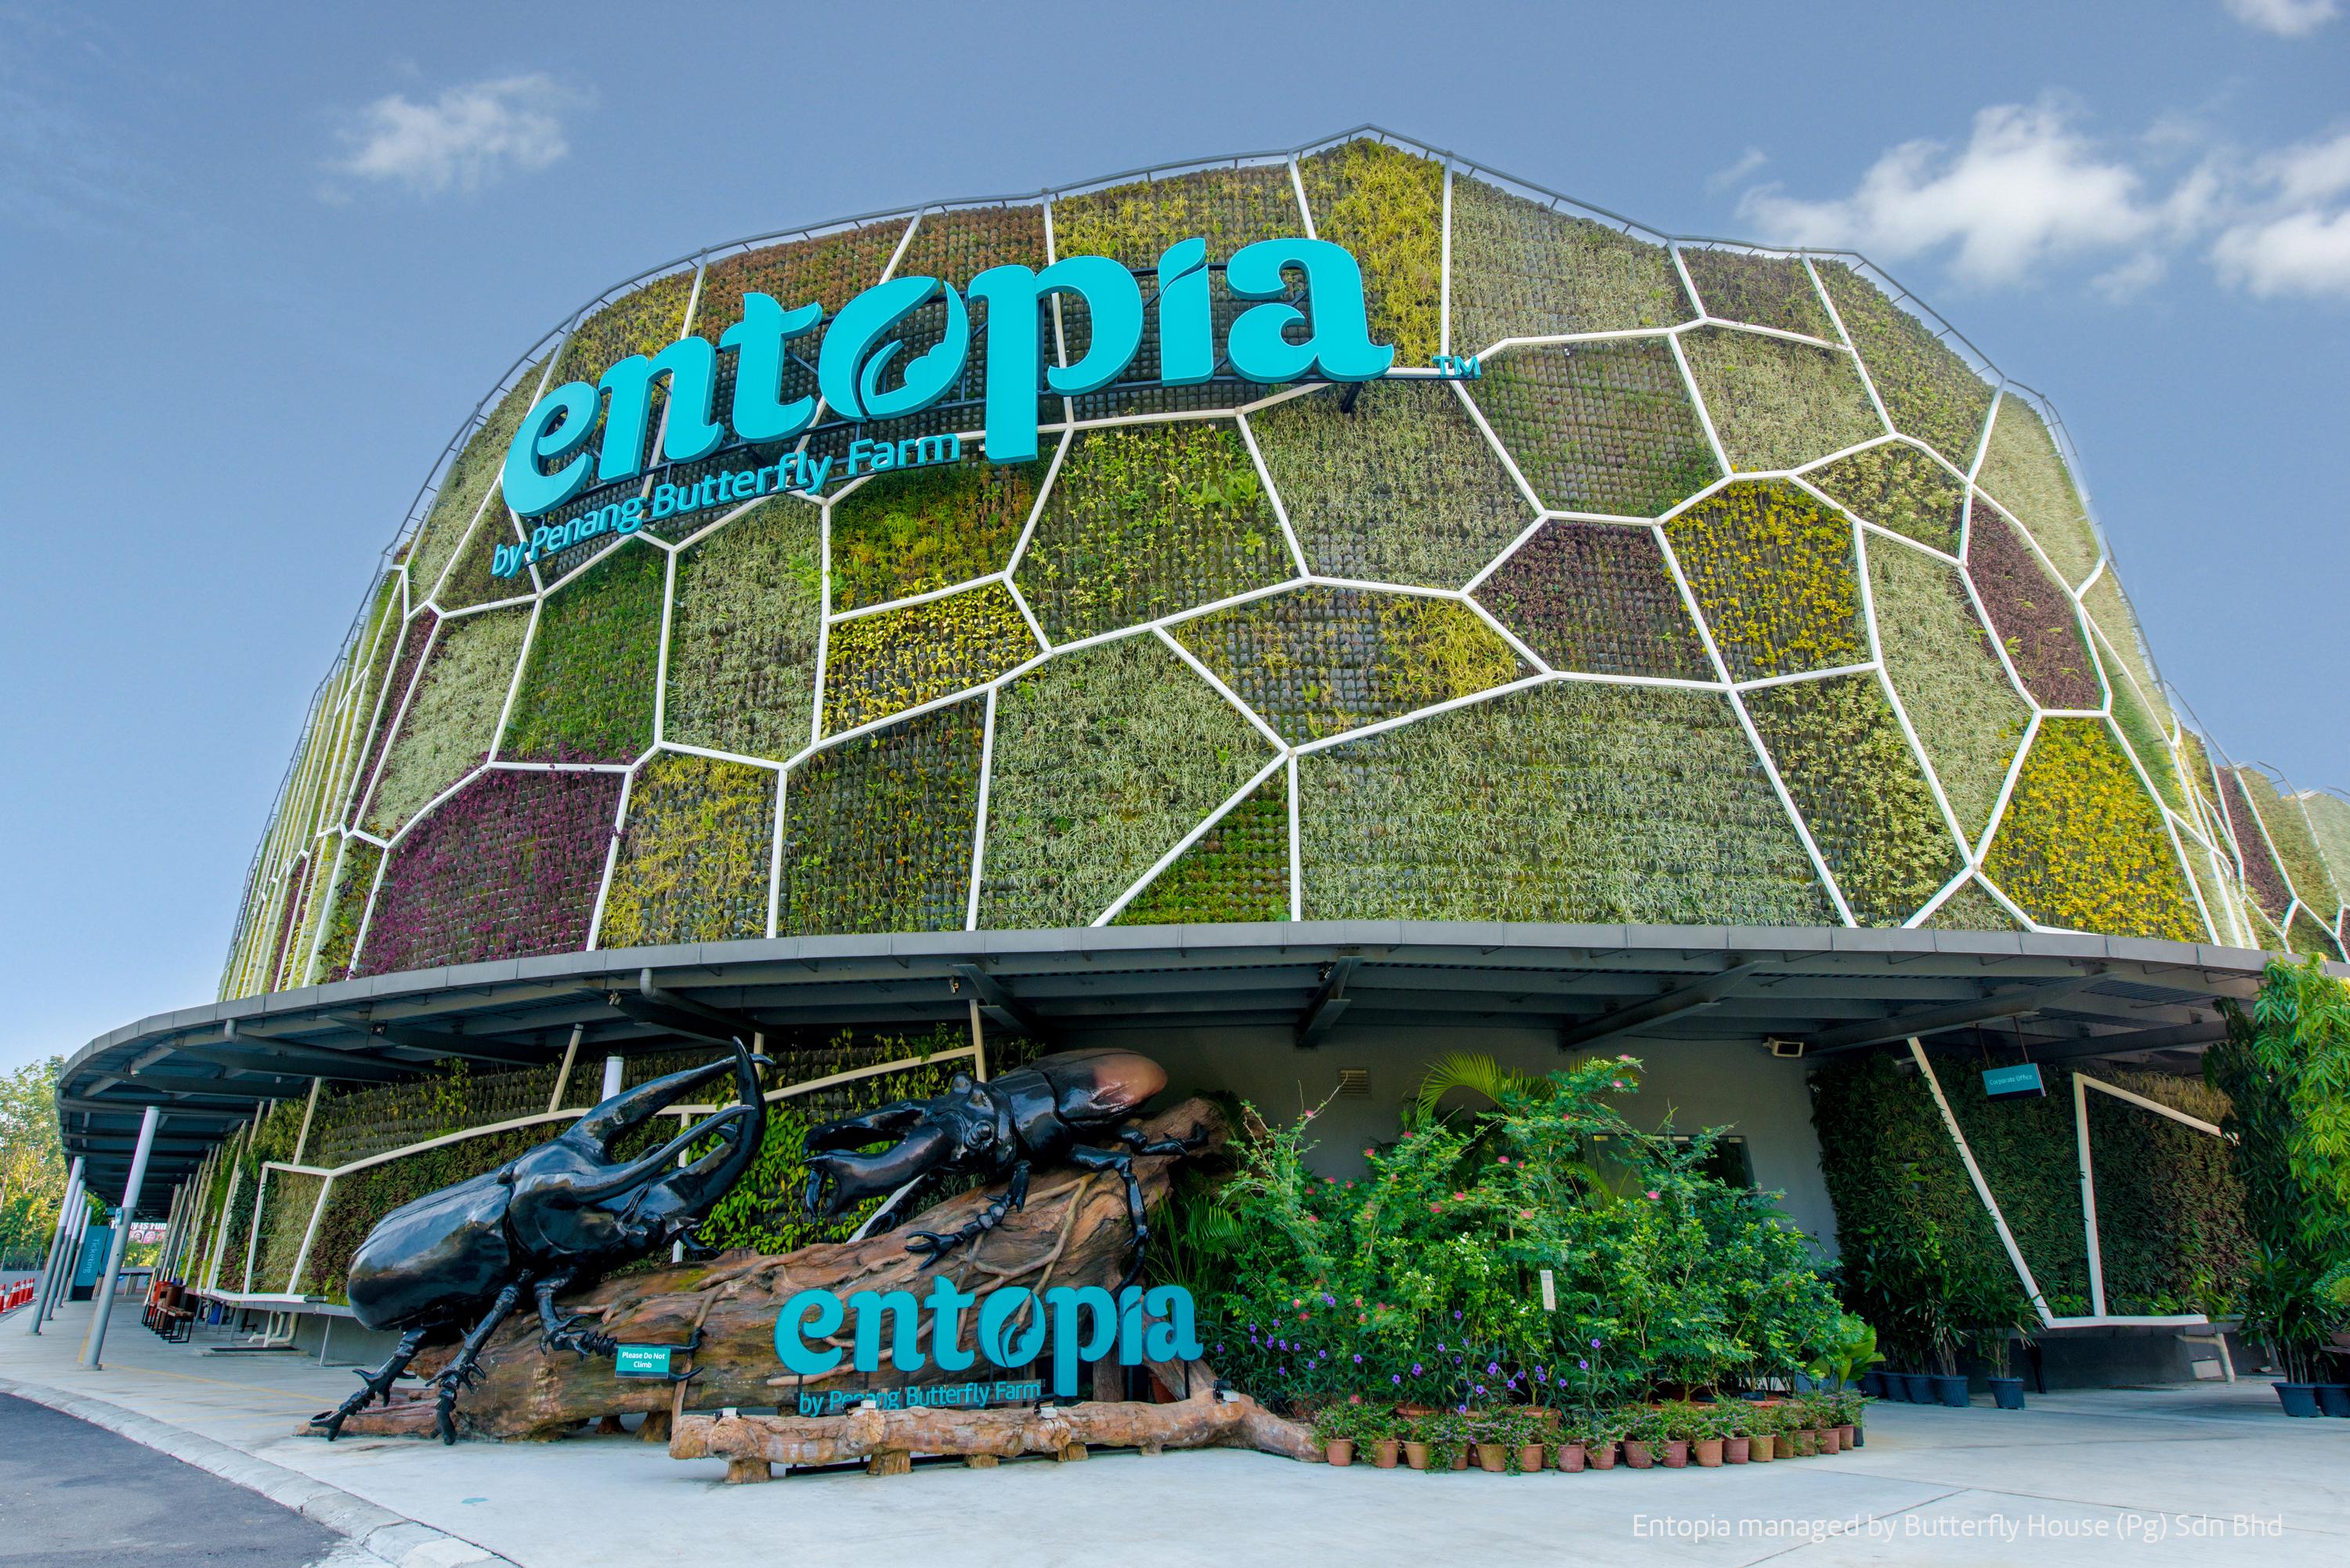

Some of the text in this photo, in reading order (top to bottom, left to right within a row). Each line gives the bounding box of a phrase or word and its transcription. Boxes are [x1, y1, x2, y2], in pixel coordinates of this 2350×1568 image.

[502, 237, 1481, 517] entopia TM
[490, 433, 961, 580] by Penang Butterfly Farm
[1989, 1077, 2016, 1086] Corporate
[82, 1237, 101, 1274] Ticketing
[774, 1275, 1203, 1397] entopia
[799, 1392, 824, 1418] by
[906, 1382, 990, 1407] Butterfly
[995, 1381, 1041, 1401] Farm
